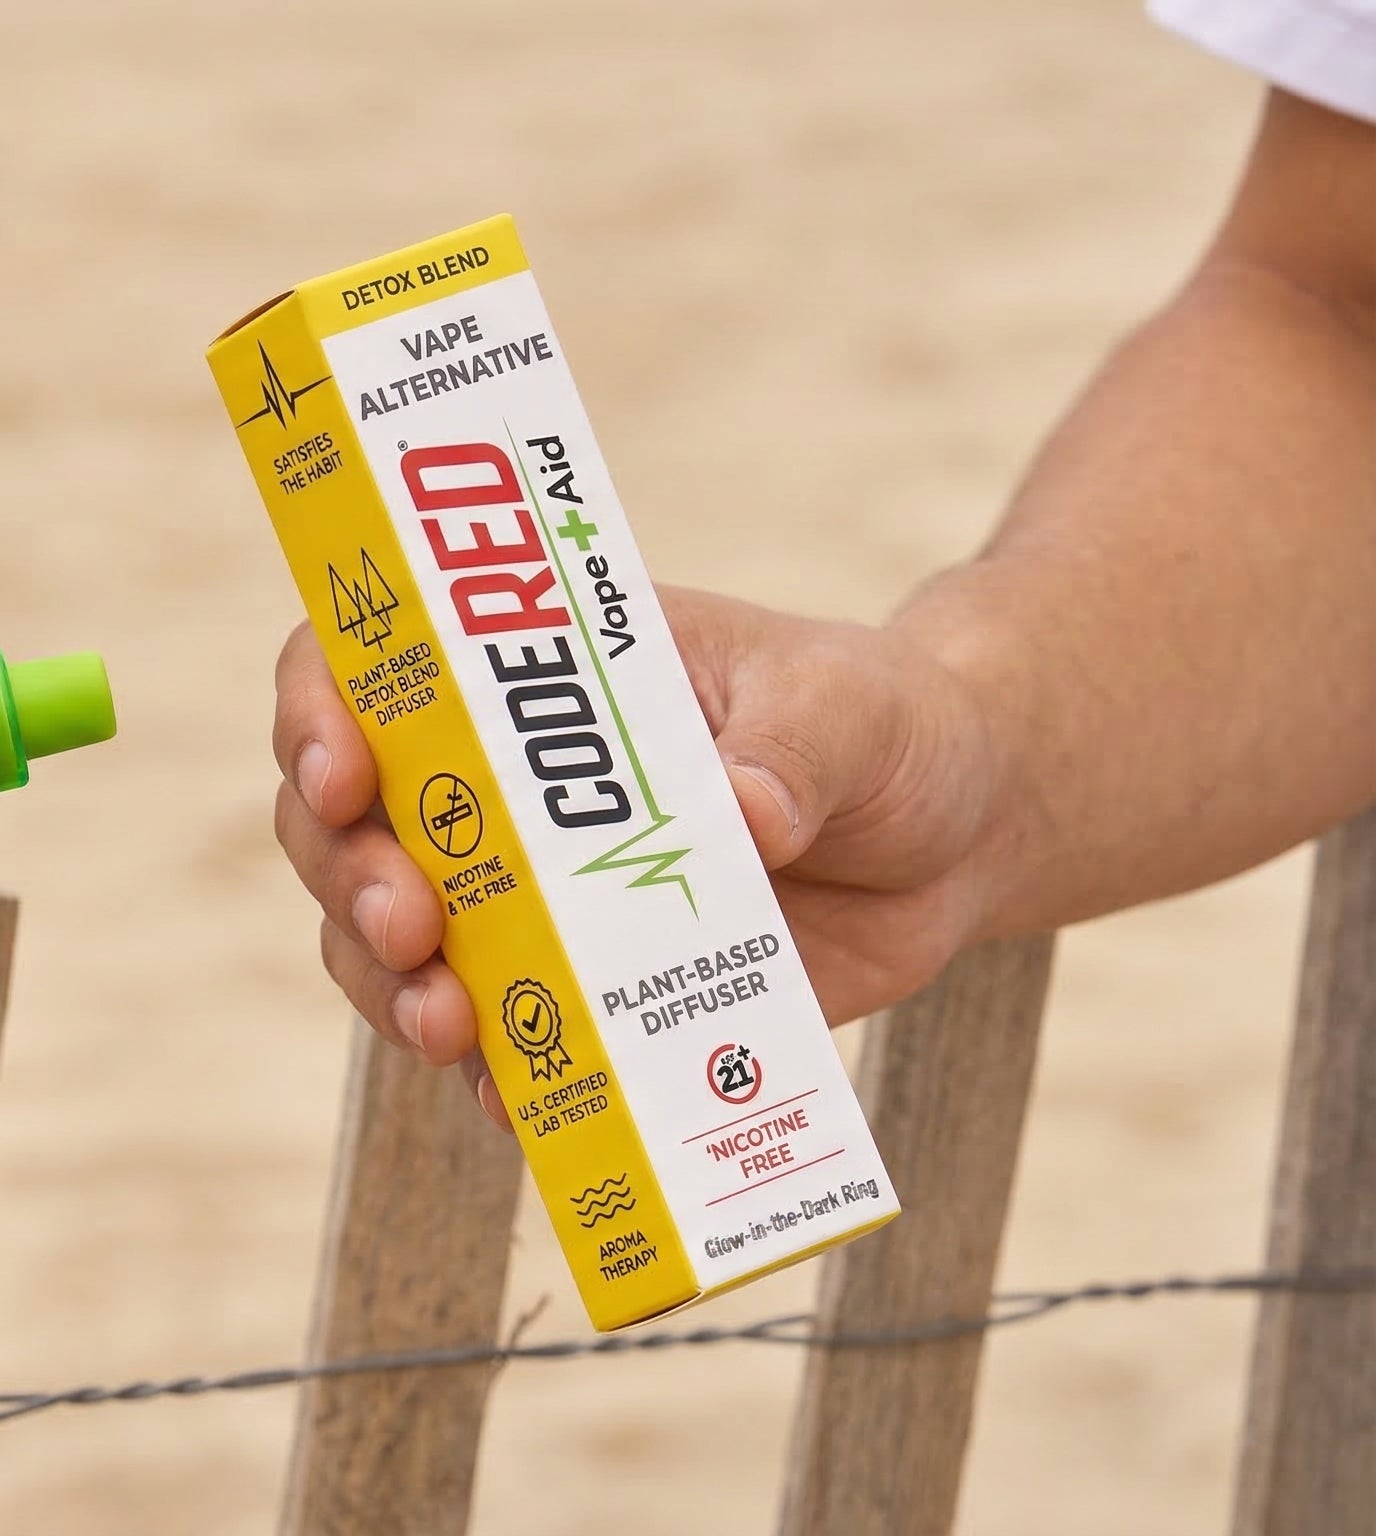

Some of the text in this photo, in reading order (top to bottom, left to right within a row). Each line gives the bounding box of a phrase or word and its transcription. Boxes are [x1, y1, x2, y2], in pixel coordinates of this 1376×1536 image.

[342, 246, 490, 312] DETOX BLEND
[400, 315, 483, 361] VAPE
[360, 333, 553, 421] ALTERNATIVE
[273, 432, 334, 475] SATISFIES
[280, 451, 345, 496] THE HABIT
[348, 642, 431, 694] PLANT-BASED
[355, 661, 440, 713] DETOX BLEND
[376, 686, 438, 726] DIFFUSER
[443, 856, 504, 893] NICOTINE
[448, 873, 518, 915] & THC FREE
[602, 933, 779, 1016] PLANT-BASED
[640, 971, 769, 1036] DIFFUSER
[518, 1071, 609, 1121] U.S. CERTIFIED
[534, 1095, 609, 1137] LAB TESTED
[739, 1143, 794, 1179] FREE
[841, 1179, 880, 1204] Ring
[600, 1230, 647, 1262] AROMA
[600, 1246, 659, 1282] THERAPY
